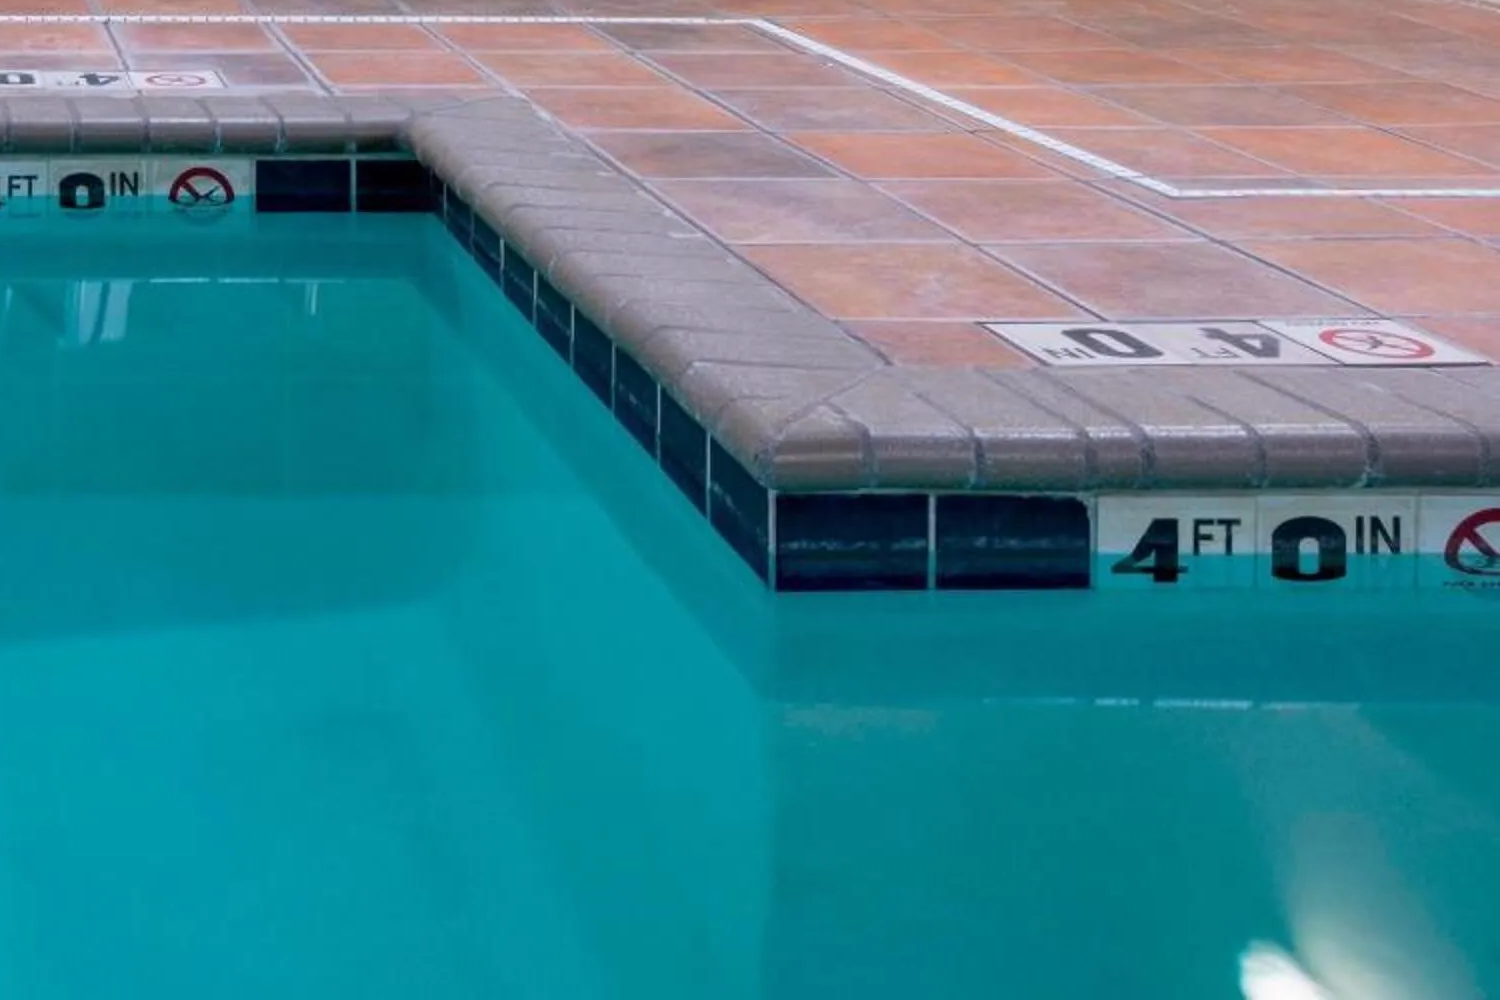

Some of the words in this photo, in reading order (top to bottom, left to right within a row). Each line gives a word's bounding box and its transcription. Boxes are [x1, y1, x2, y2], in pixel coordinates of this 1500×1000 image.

[78, 72, 119, 86] 4
[7, 174, 38, 198] FT
[109, 171, 139, 197] IN
[1199, 327, 1281, 358] 4
[1111, 517, 1188, 583] 4
[1192, 518, 1241, 556] FT
[1271, 515, 1347, 582] 0
[1355, 515, 1401, 555] IN
